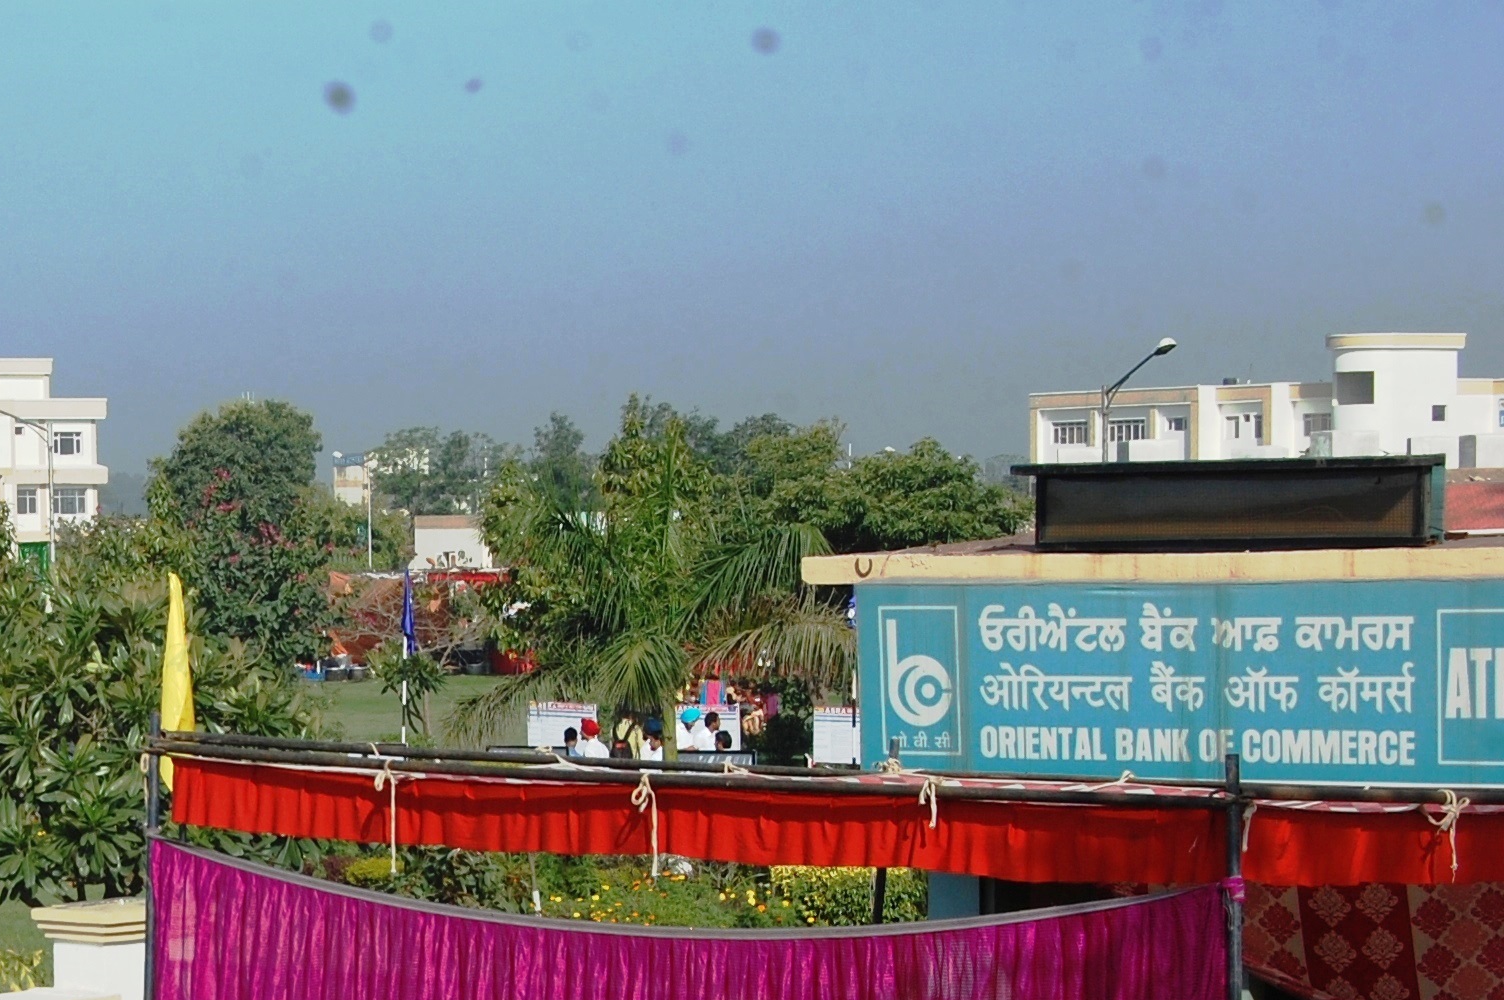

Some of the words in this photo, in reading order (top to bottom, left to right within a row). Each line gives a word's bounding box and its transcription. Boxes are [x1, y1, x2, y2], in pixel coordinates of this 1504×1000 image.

[1149, 662, 1205, 713] बैंक
[1317, 662, 1415, 714] कॉमर्स
[979, 726, 1107, 761] ORIENTAL
[1115, 727, 1191, 762] BANK
[1199, 729, 1234, 763] OF
[1241, 729, 1416, 766] COMMERCE
